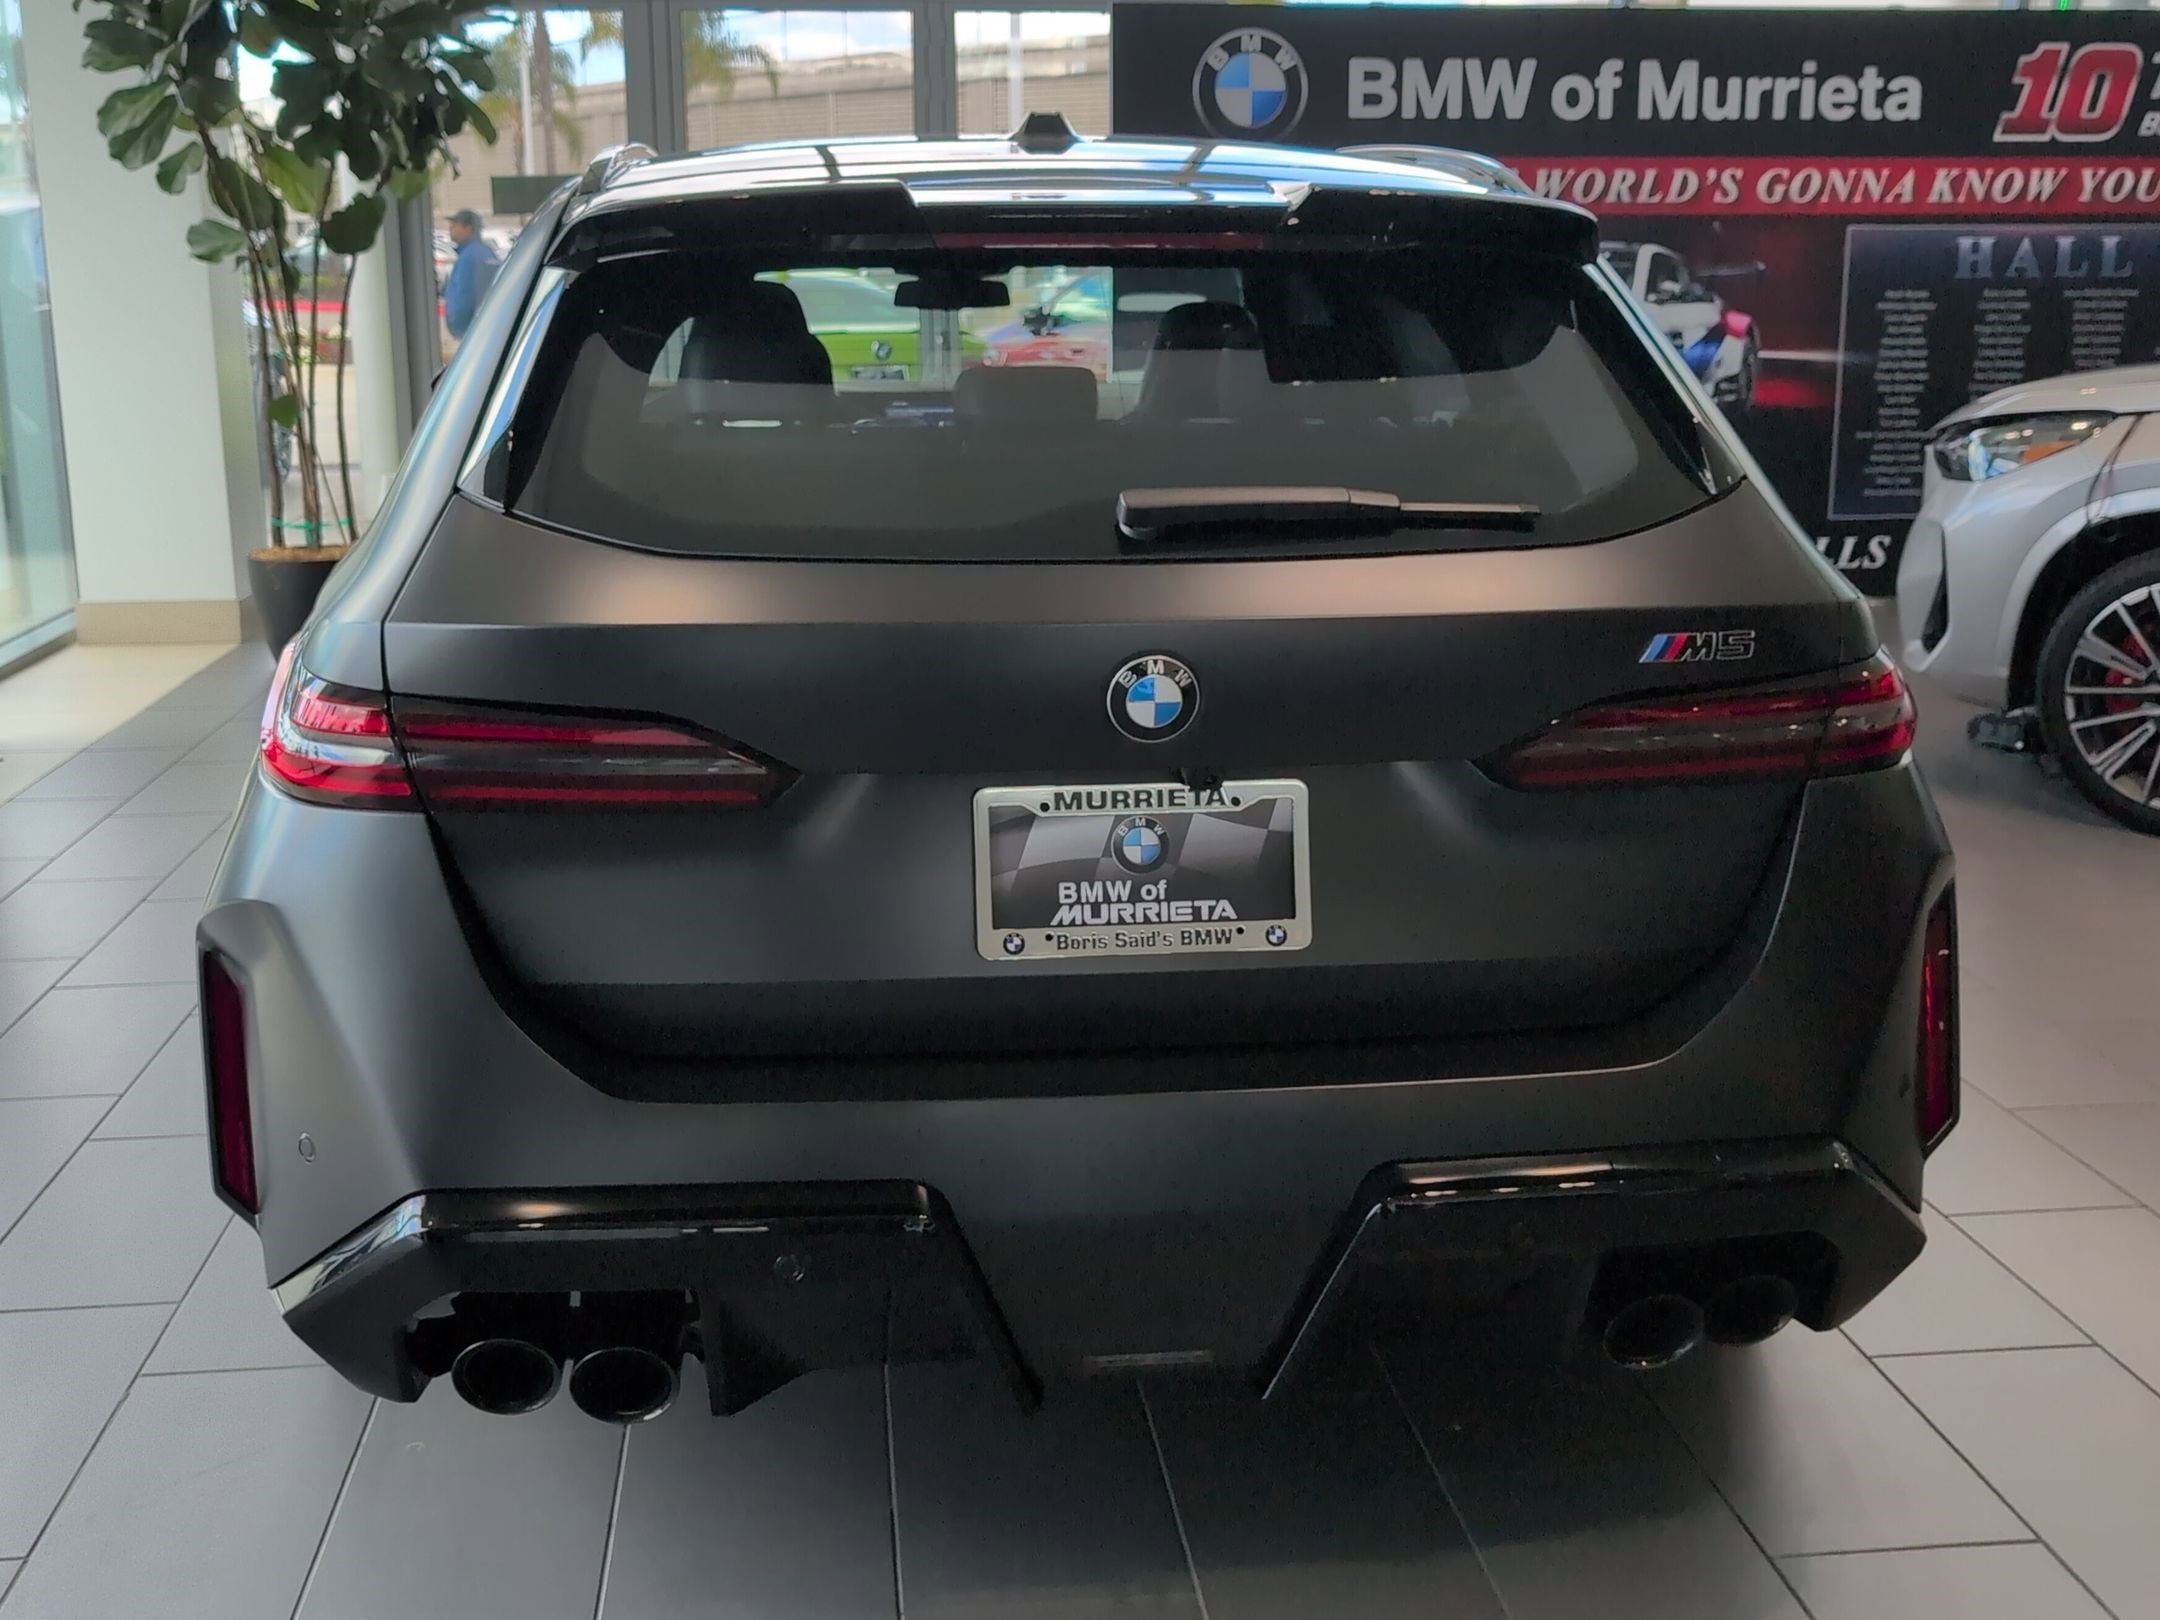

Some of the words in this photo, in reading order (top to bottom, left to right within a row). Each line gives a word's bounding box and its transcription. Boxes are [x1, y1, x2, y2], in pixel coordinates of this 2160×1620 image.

[1206, 33, 1298, 72] BMW
[1347, 56, 1538, 121] BMW
[1550, 58, 1623, 122] of
[1637, 59, 1923, 122] Murrieta
[1992, 42, 2144, 143] 10
[1535, 166, 1744, 205] WORLD'S
[1755, 166, 1916, 205] GONNA
[1927, 167, 2069, 204] KNOW
[1954, 235, 2134, 280] HALL
[1117, 659, 1193, 689] BMW
[1053, 787, 1228, 812] MURRIETA
[1117, 816, 1168, 836] BMW
[1058, 880, 1132, 905] BMW
[1140, 878, 1168, 901] of
[1049, 899, 1238, 926] MURRIETA
[1056, 933, 1108, 951] Boris
[1115, 929, 1174, 948] Said's
[1180, 927, 1233, 945] BMW
